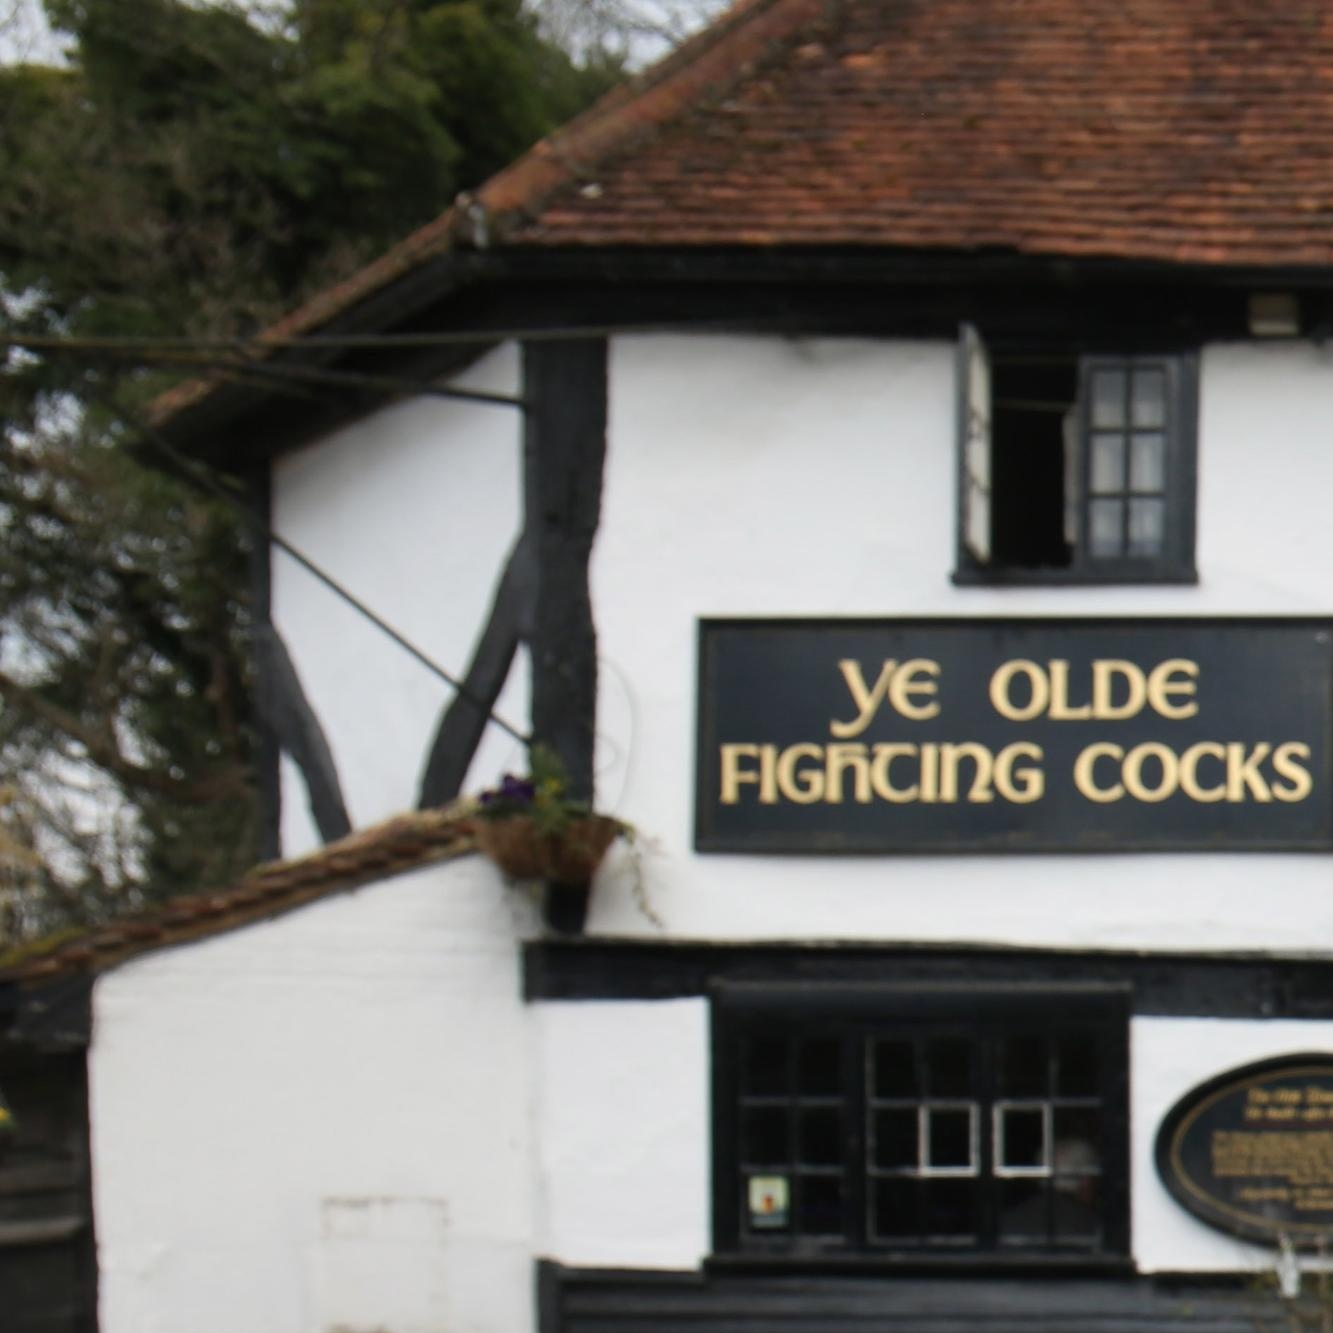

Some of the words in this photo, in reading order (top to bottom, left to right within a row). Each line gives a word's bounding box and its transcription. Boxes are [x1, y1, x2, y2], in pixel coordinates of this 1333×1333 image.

[989, 658, 1199, 721] OLDE
[719, 742, 1045, 804] FIGHTING
[1073, 742, 1313, 803] COCKS
